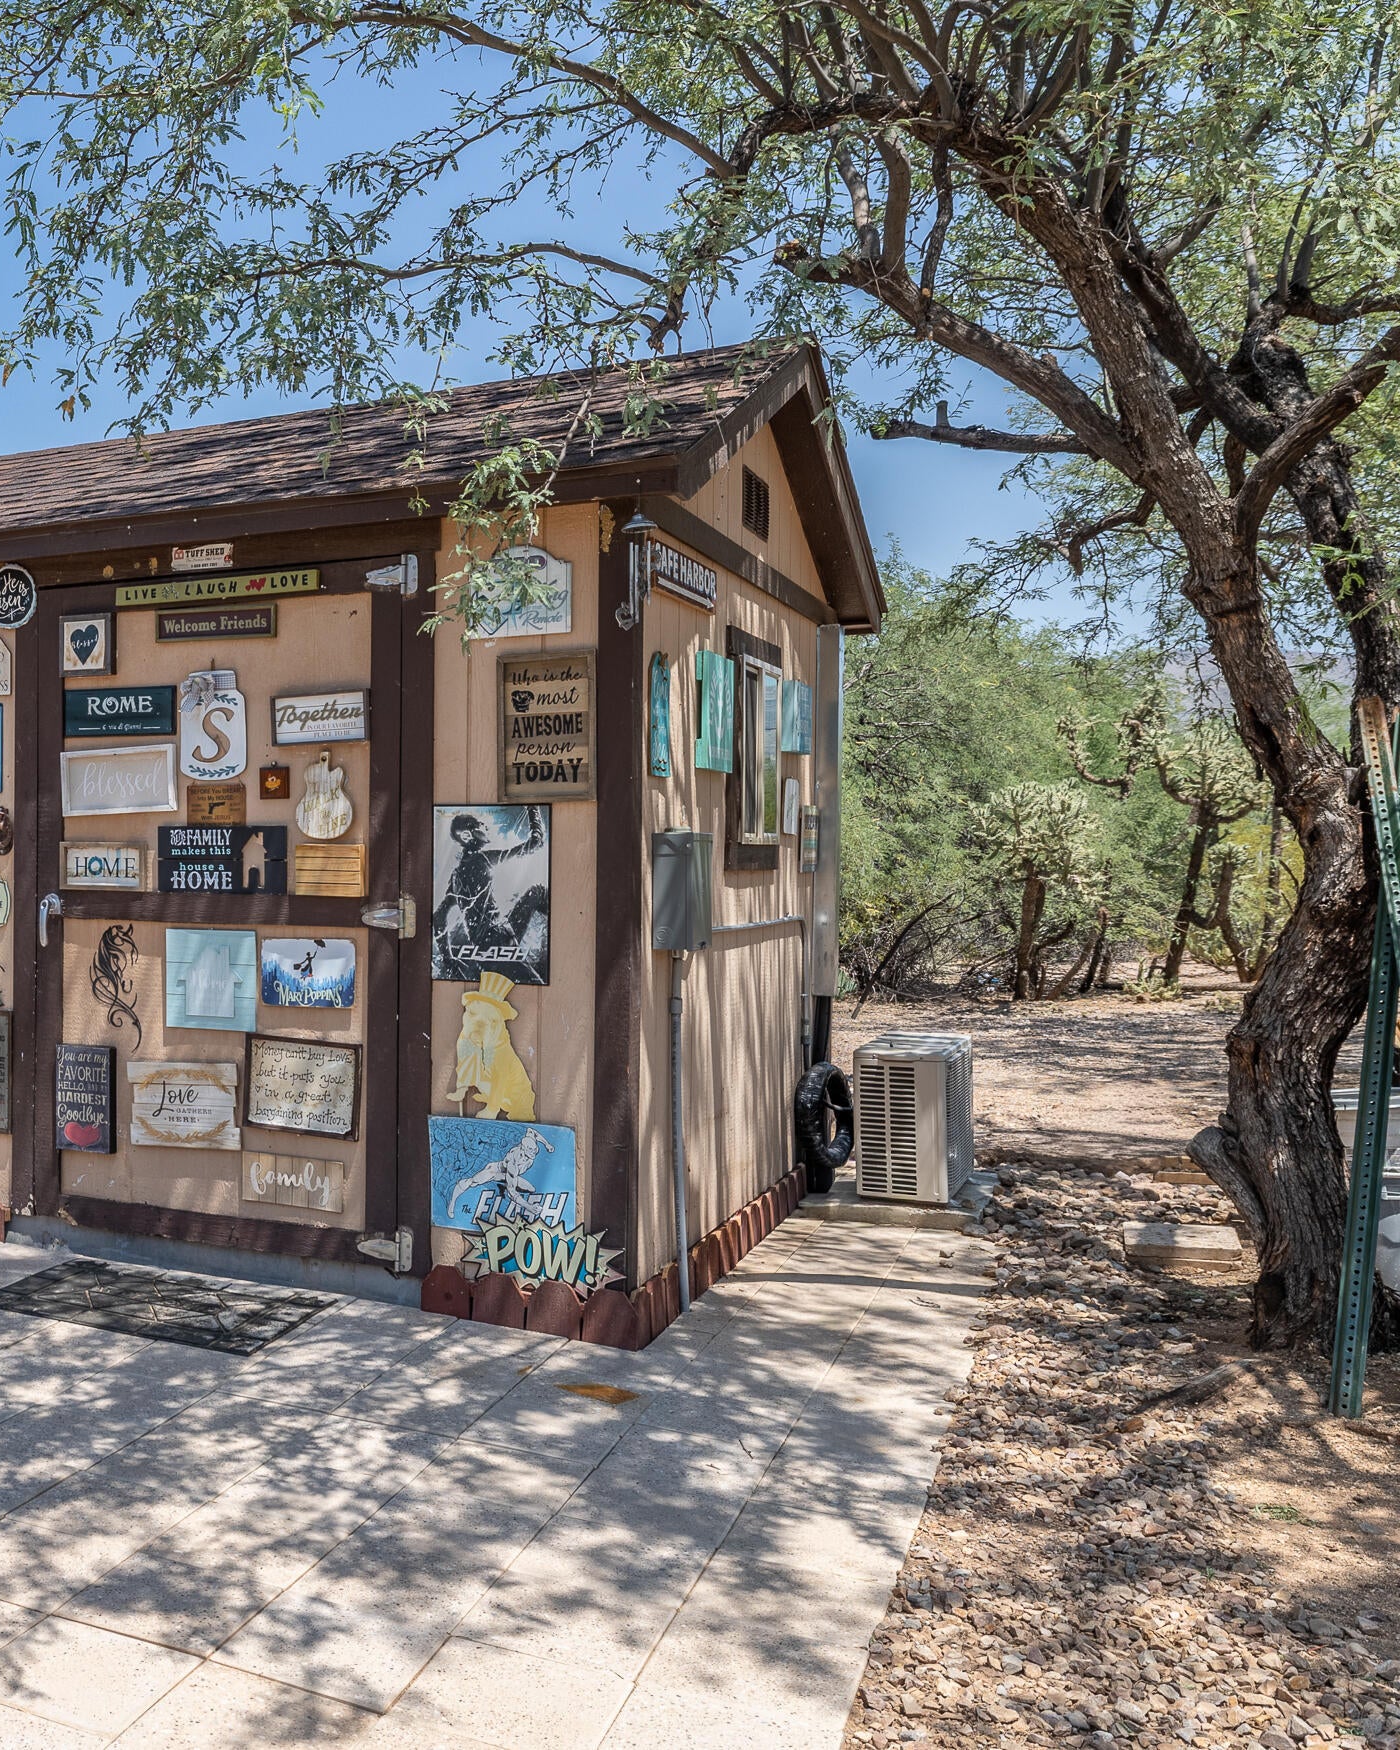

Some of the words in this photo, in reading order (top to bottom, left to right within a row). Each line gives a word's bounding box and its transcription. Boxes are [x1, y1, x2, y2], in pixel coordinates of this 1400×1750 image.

[185, 549, 204, 558] TUFF
[205, 547, 225, 556] SHED
[2, 573, 19, 595] He
[19, 581, 29, 596] is
[125, 587, 157, 601] LIVE
[185, 581, 238, 596] LAUGH
[271, 573, 309, 588] LOVE
[680, 555, 717, 600] HARBOR
[163, 618, 217, 634] Welcome
[220, 614, 268, 631] Friends
[543, 670, 557, 681] is
[560, 666, 583, 681] the
[87, 695, 153, 715] ROME
[536, 686, 580, 705] most
[276, 699, 364, 731] Together
[511, 712, 583, 738] AWESOME
[192, 707, 234, 763] S
[515, 742, 576, 761] person
[75, 758, 163, 799] blessed
[511, 758, 583, 785] TODAY
[187, 829, 232, 846] FAMILY
[171, 846, 206, 856] makes
[210, 846, 231, 855] this
[74, 856, 137, 879] HOME
[179, 862, 215, 871] house
[170, 871, 233, 890] HOME
[457, 944, 530, 962] FLASH
[57, 1047, 76, 1066] You
[77, 1053, 91, 1063] are
[94, 1054, 107, 1070] my
[254, 1041, 284, 1062] Money
[308, 1048, 325, 1066] buy
[58, 1065, 107, 1083] FAVORITE
[255, 1061, 276, 1077] but
[278, 1065, 288, 1080] it
[290, 1069, 314, 1086] puts
[319, 1074, 345, 1089] you
[58, 1091, 107, 1106] HARDEST
[152, 1080, 199, 1117] Love
[264, 1083, 279, 1097] in
[285, 1090, 294, 1099] a
[294, 1090, 332, 1104] great
[57, 1103, 108, 1129] Goodbye.
[175, 1107, 212, 1115] GATHERS
[255, 1100, 303, 1125] bargaining
[306, 1108, 347, 1128] position
[250, 1161, 330, 1207] family
[462, 1204, 472, 1214] The
[485, 1225, 599, 1288] POW!
